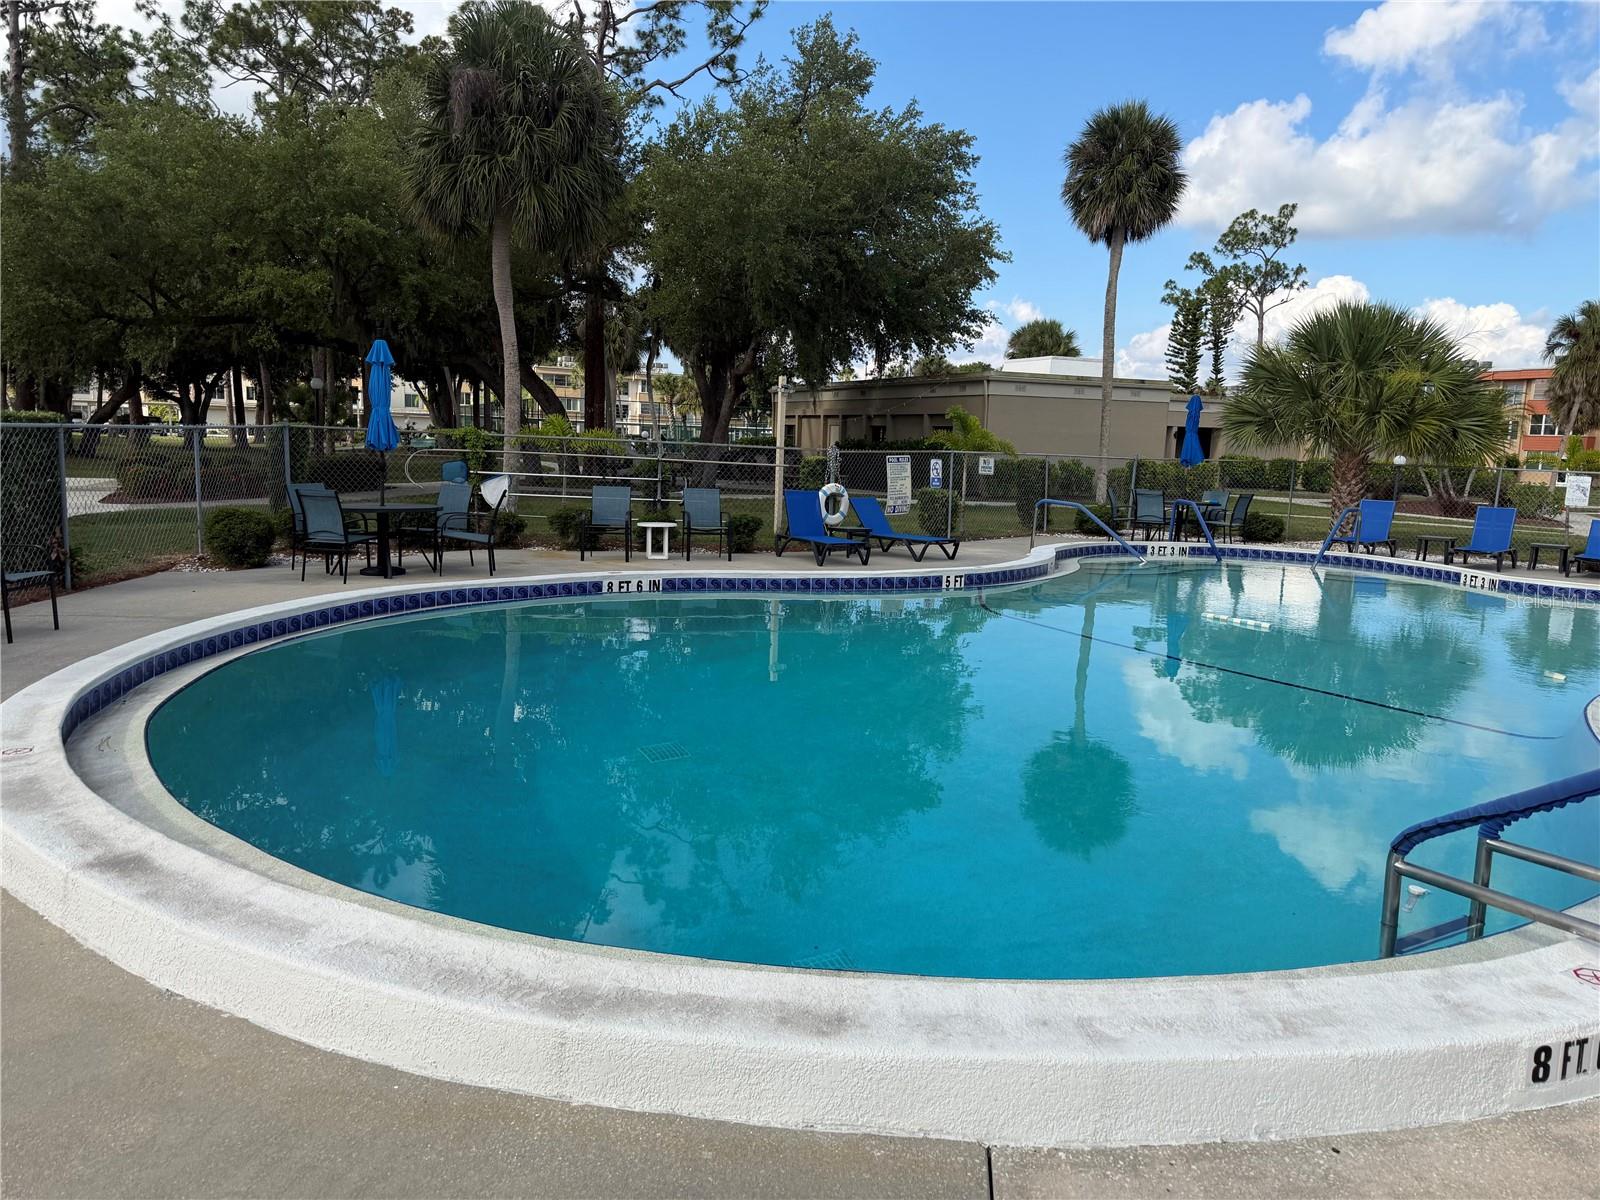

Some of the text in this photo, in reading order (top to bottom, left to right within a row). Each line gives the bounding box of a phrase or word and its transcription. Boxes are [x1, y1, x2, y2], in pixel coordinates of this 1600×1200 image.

[1150, 545, 1155, 557] 3
[1170, 546, 1175, 557] 3
[1178, 546, 1187, 557] IN
[607, 579, 660, 594] 8 FT 6 IN
[945, 575, 963, 588] 5 FT
[1462, 573, 1498, 591] 3 FT 3 IN
[1531, 1045, 1552, 1083] 8
[1560, 1037, 1588, 1080] FT.
